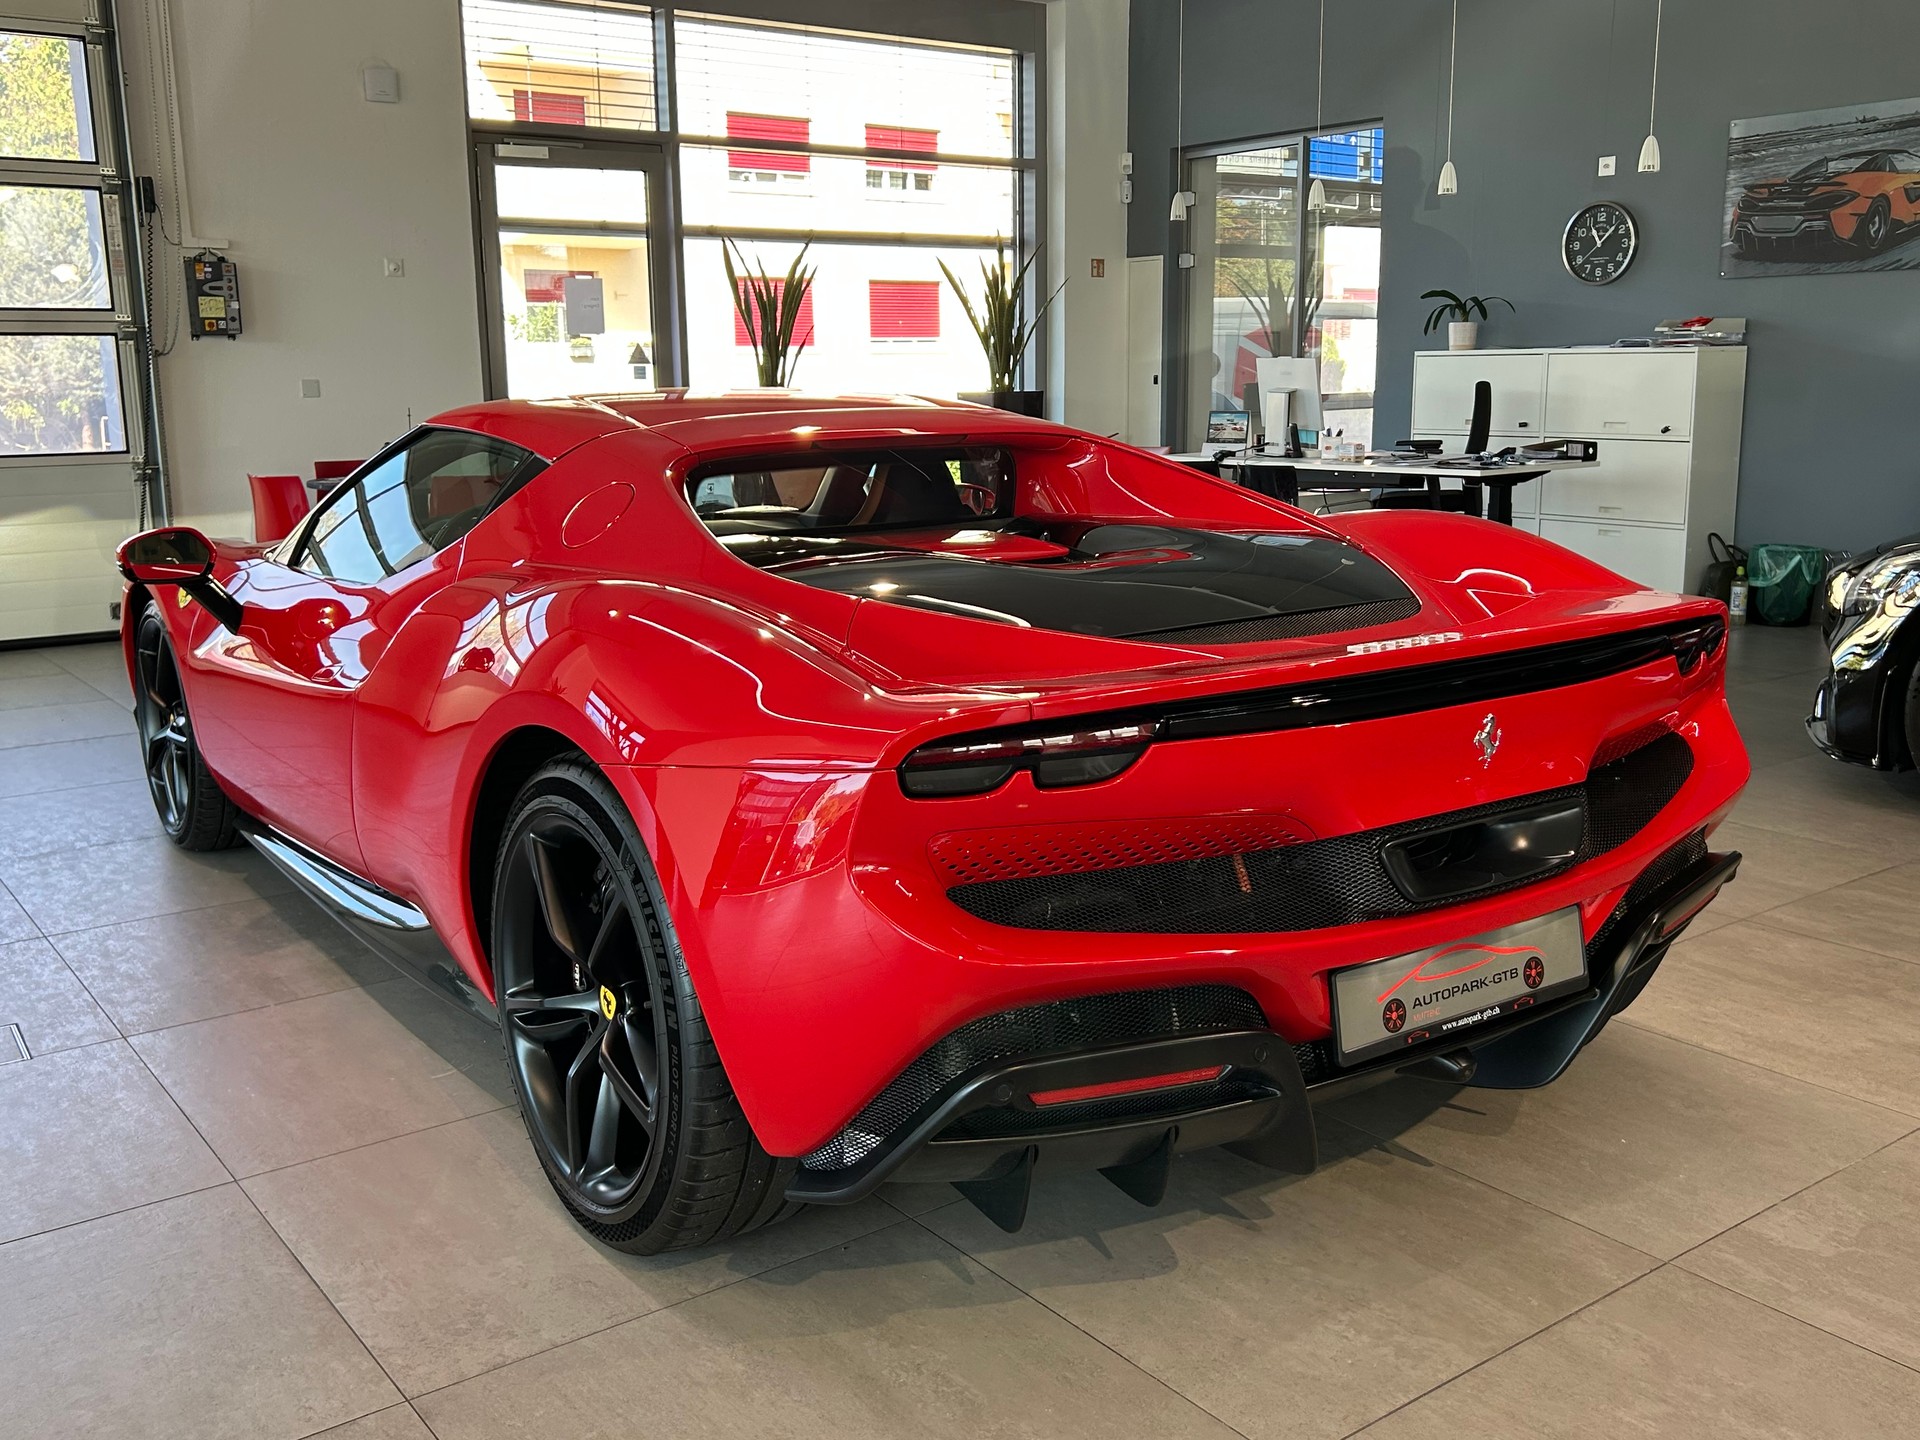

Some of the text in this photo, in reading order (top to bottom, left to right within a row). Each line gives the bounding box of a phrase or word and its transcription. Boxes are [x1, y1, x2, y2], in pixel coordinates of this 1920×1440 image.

[1598, 213, 1606, 221] 12
[1578, 228, 1586, 237] 10
[1619, 225, 1625, 234] 2
[1573, 242, 1580, 250] 9
[1622, 239, 1628, 247] 3
[1576, 255, 1583, 264] 8
[1616, 253, 1623, 261] 4
[1584, 265, 1591, 273] 7
[1595, 268, 1602, 276] 6
[1607, 264, 1614, 272] 5
[635, 882, 677, 1030] MICHELIN
[1413, 968, 1519, 1009] AUTOPARK-GTB
[1442, 1006, 1501, 1030] www.autopark-gtb.ch
[669, 1044, 680, 1090] PILOT
[668, 1091, 680, 1142] SPORT
